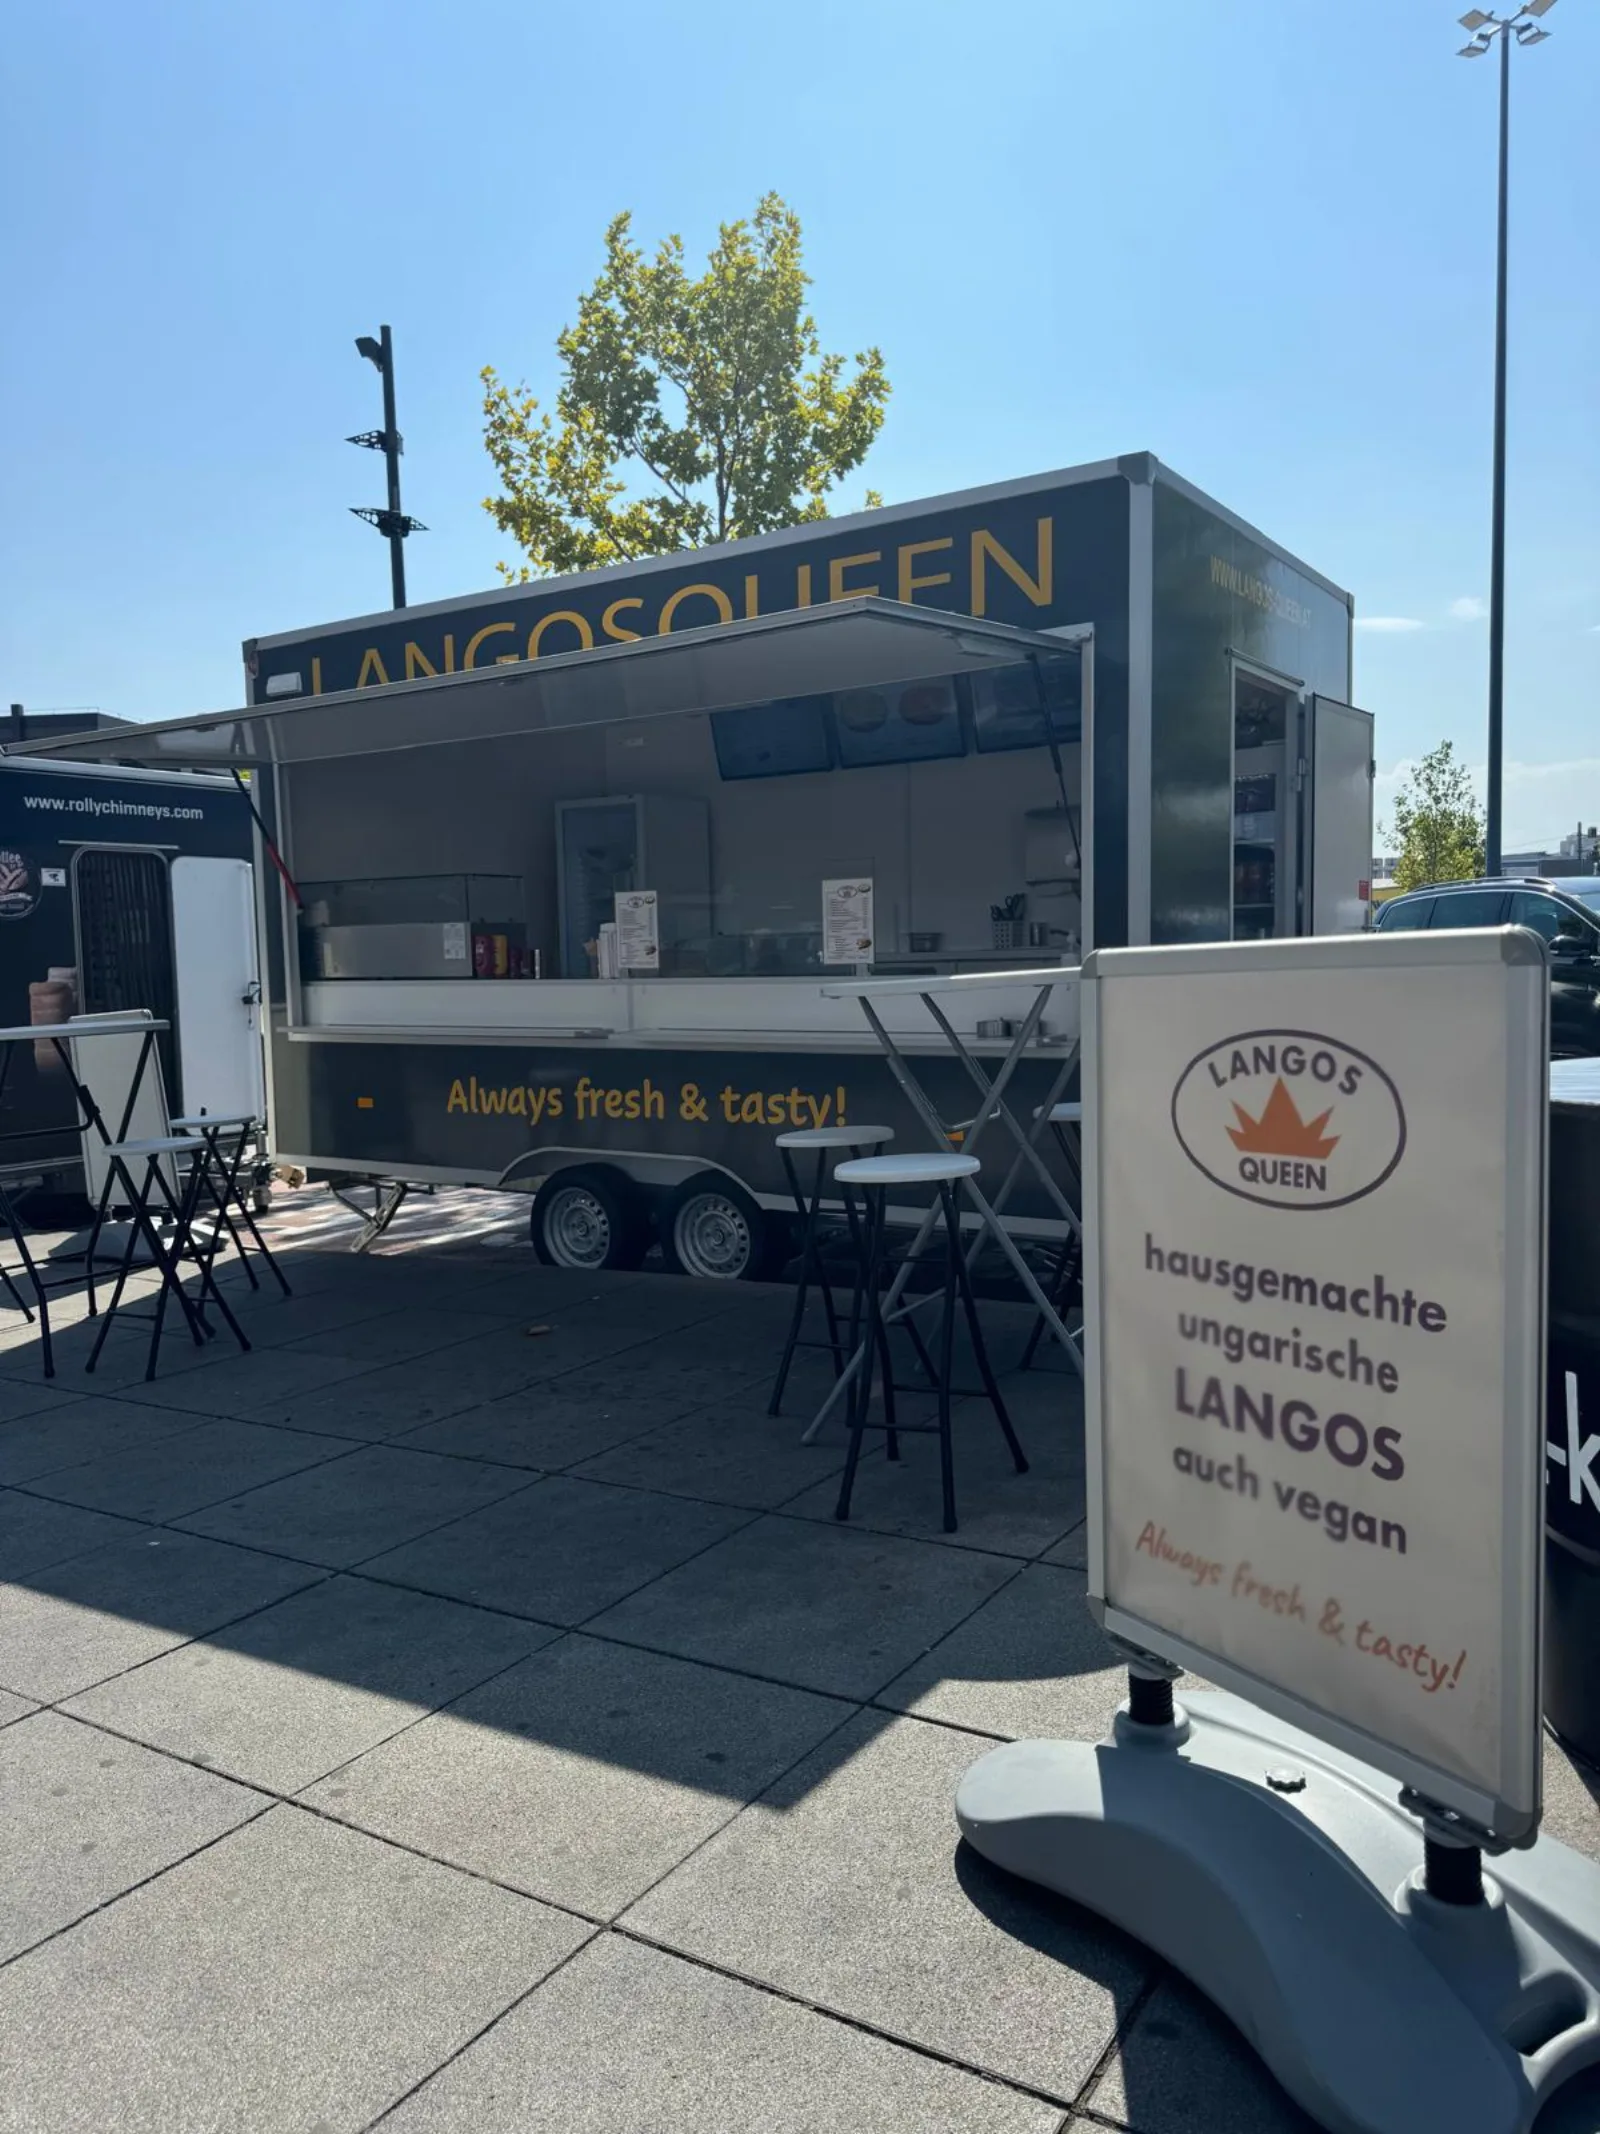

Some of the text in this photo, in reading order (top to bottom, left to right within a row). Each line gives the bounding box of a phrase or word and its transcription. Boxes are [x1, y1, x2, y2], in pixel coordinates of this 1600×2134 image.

[24, 796, 204, 820] www.rollychimneys.com
[447, 1076, 846, 1130] Always fresh & tasty!
[1208, 1045, 1363, 1096] LANGOS
[1239, 1157, 1326, 1191] QUEEN
[1145, 1233, 1447, 1333] hausgemachte
[1179, 1313, 1399, 1394] ungarische
[1175, 1367, 1405, 1482] LANGOS
[1173, 1446, 1407, 1554] auch vegan
[1135, 1520, 1466, 1692] Always fresh & tasty!
